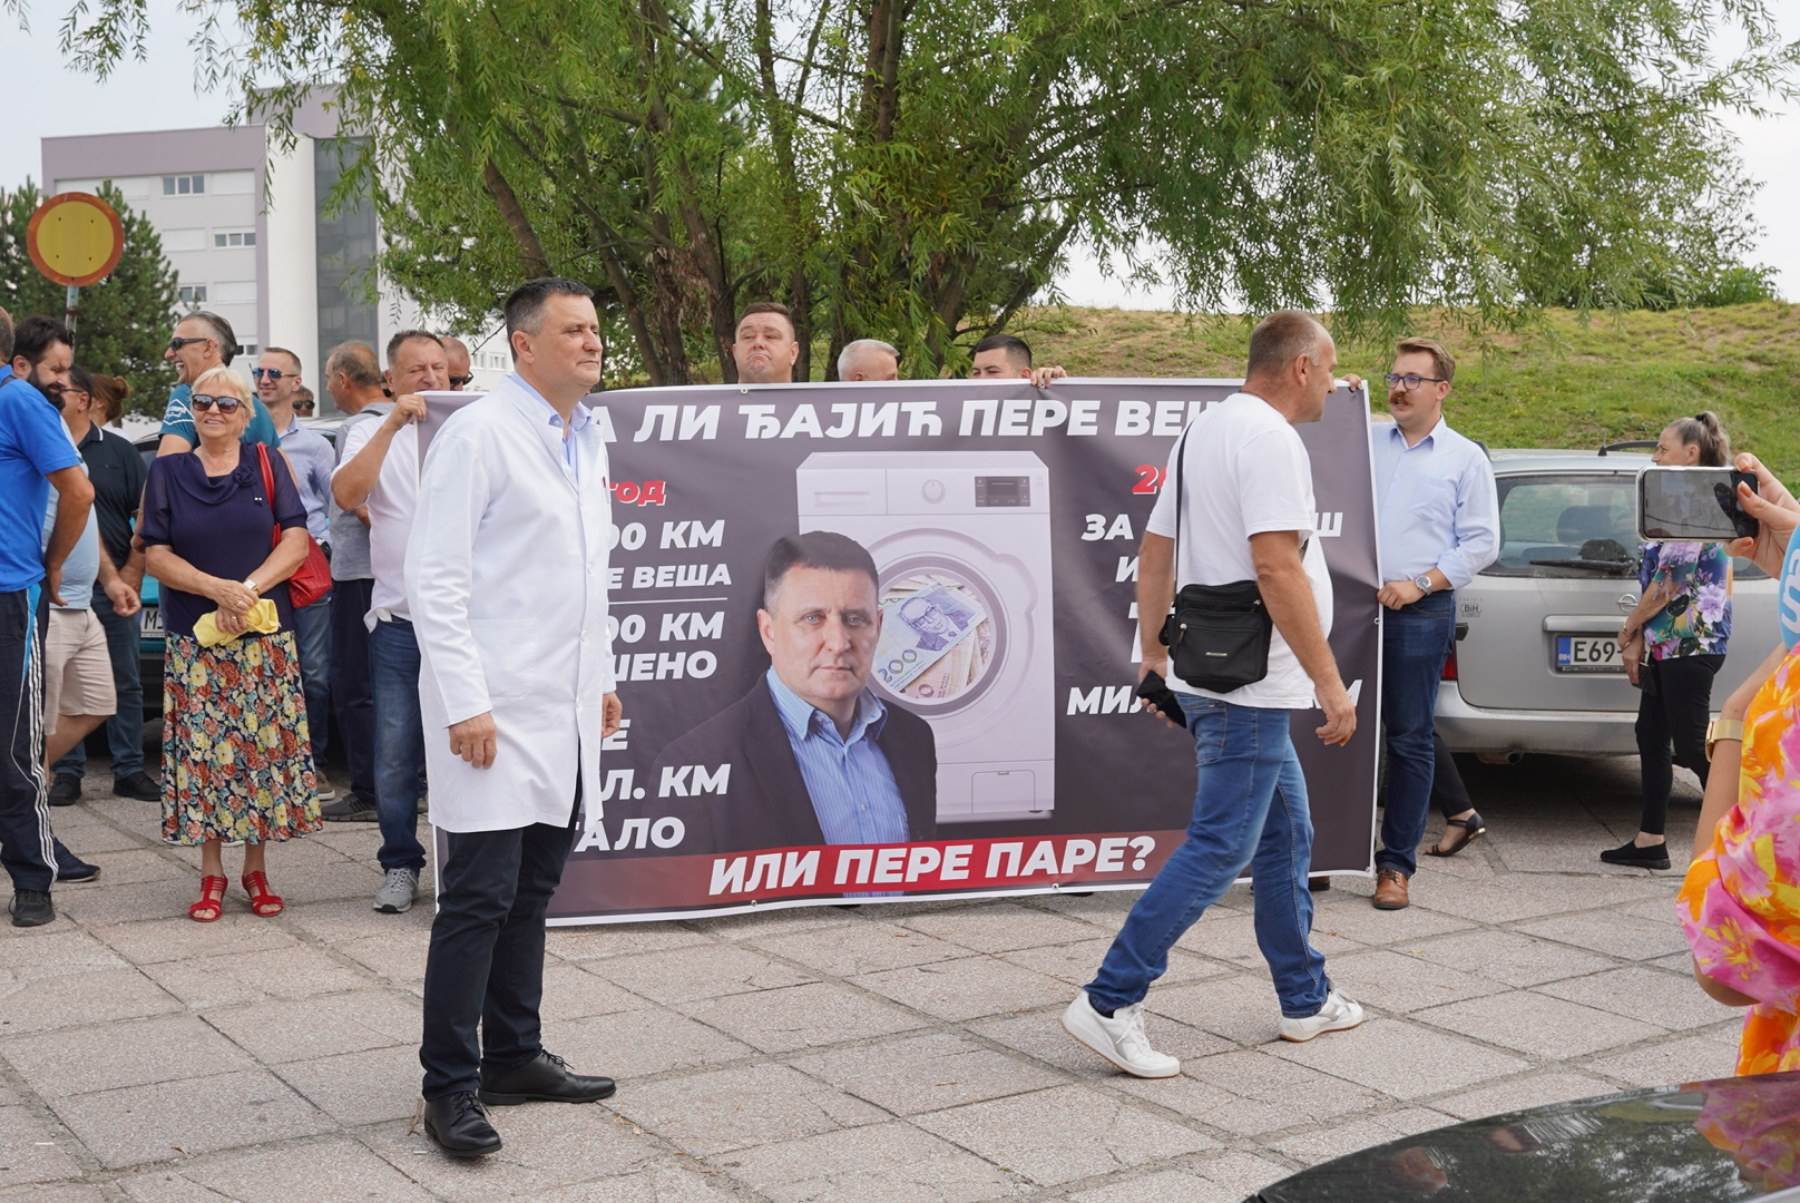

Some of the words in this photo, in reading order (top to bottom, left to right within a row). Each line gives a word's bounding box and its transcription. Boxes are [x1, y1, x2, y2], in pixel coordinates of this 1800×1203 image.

[633, 404, 721, 442] ЛИ
[738, 401, 943, 439] ЂАЈИЋ
[958, 400, 1100, 436] ПЕРЕ
[608, 479, 666, 506] од
[660, 519, 725, 549] КМ
[1080, 513, 1134, 541] ЗА
[632, 563, 732, 589] ВЕША
[659, 611, 725, 641] КМ
[658, 763, 731, 797] КМ
[709, 850, 820, 896] ИЛИ
[834, 845, 973, 885] ПЕРЕ
[985, 835, 1156, 882] ПАРЕ?
